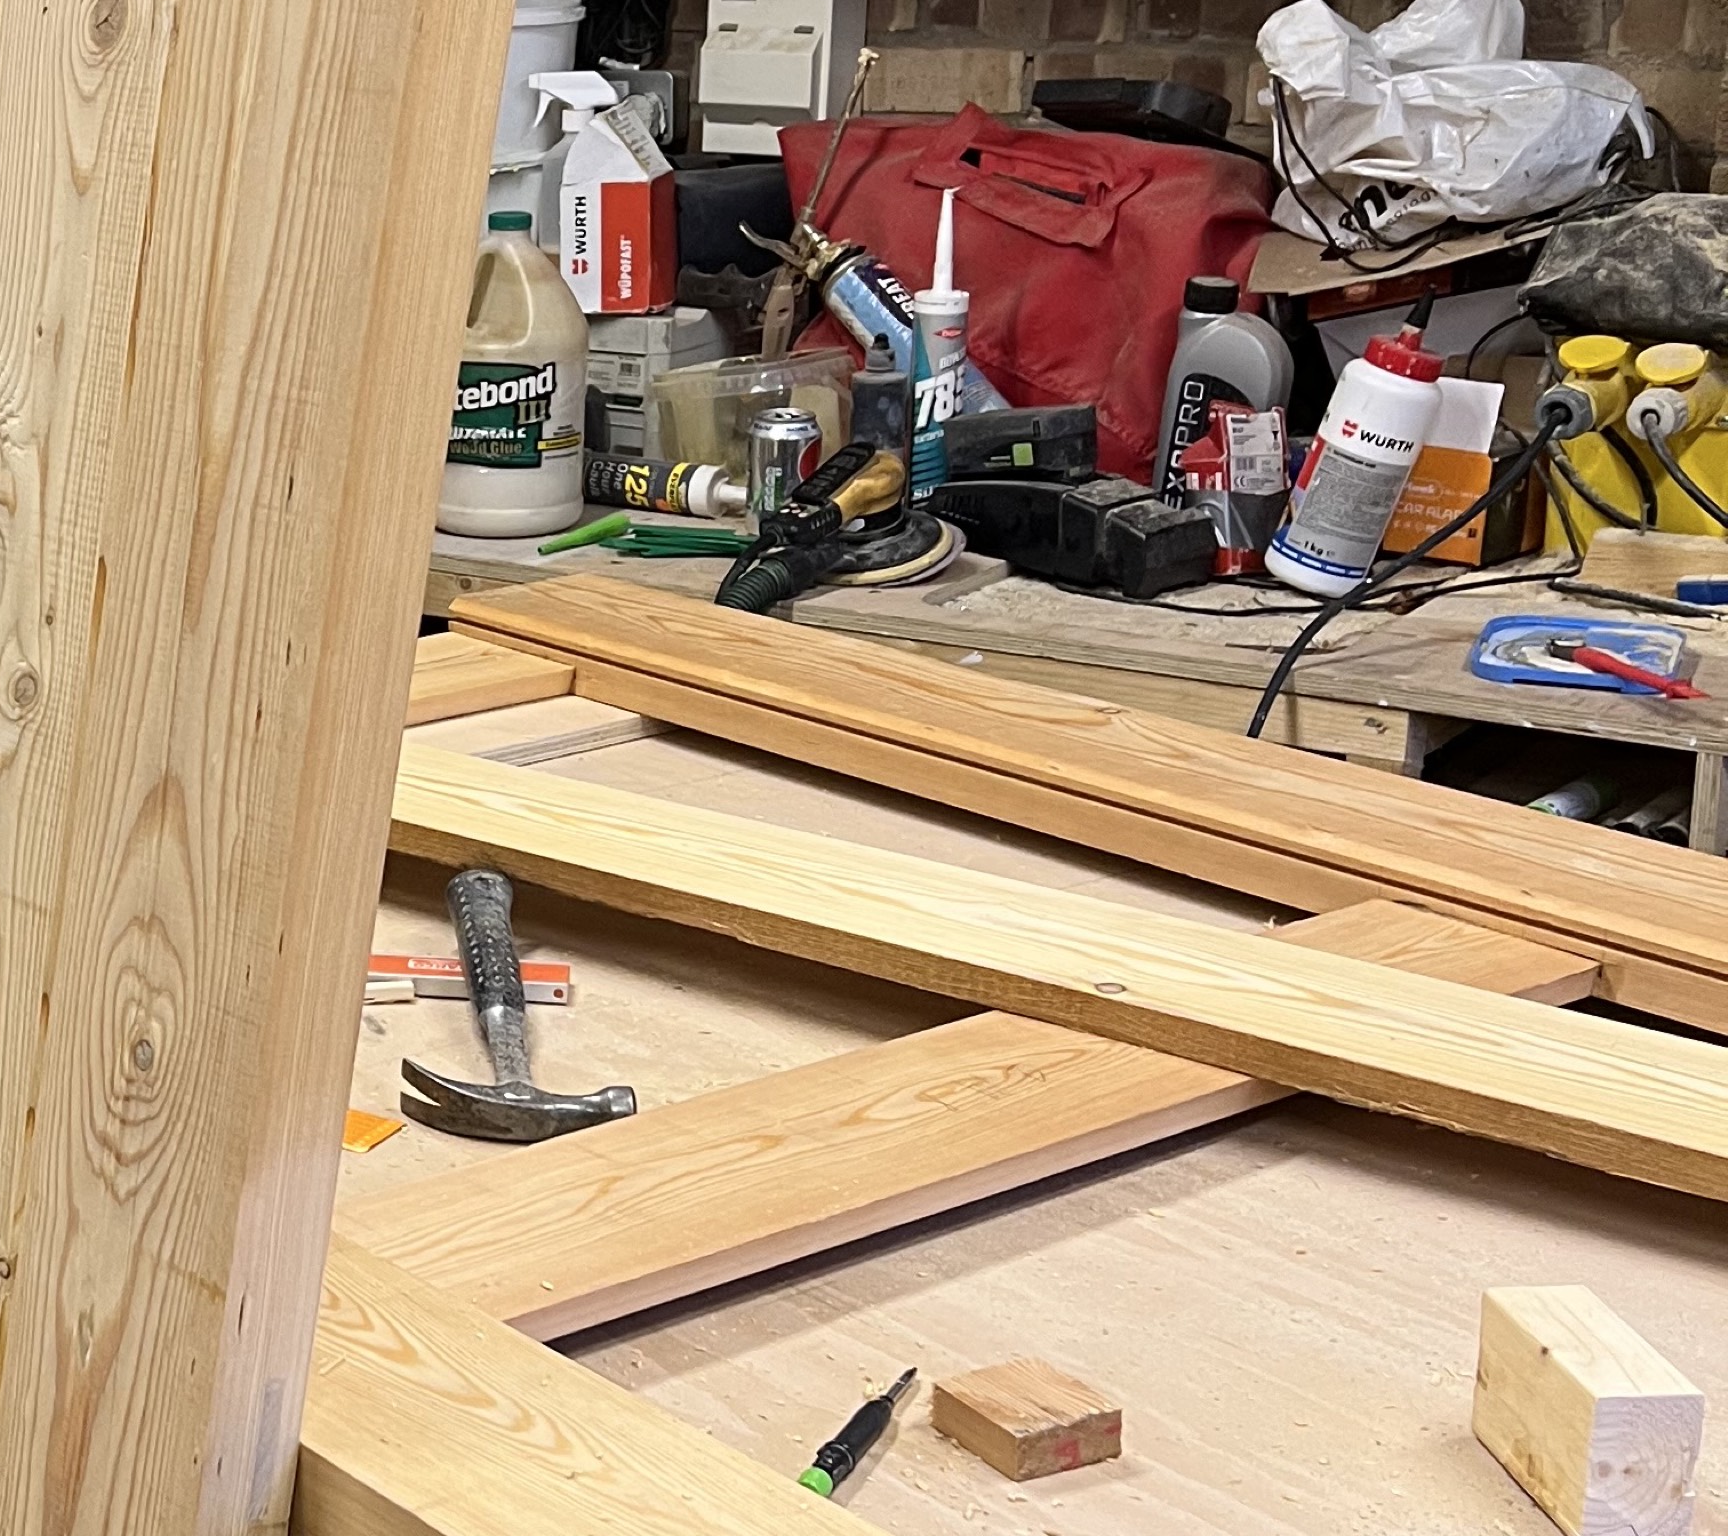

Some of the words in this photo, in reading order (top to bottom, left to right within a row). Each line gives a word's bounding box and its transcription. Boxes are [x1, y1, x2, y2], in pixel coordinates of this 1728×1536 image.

[876, 277, 915, 320] REAT
[490, 440, 523, 455] Glue
[601, 461, 616, 495] Hour
[613, 463, 628, 490] One
[624, 464, 650, 507] 125
